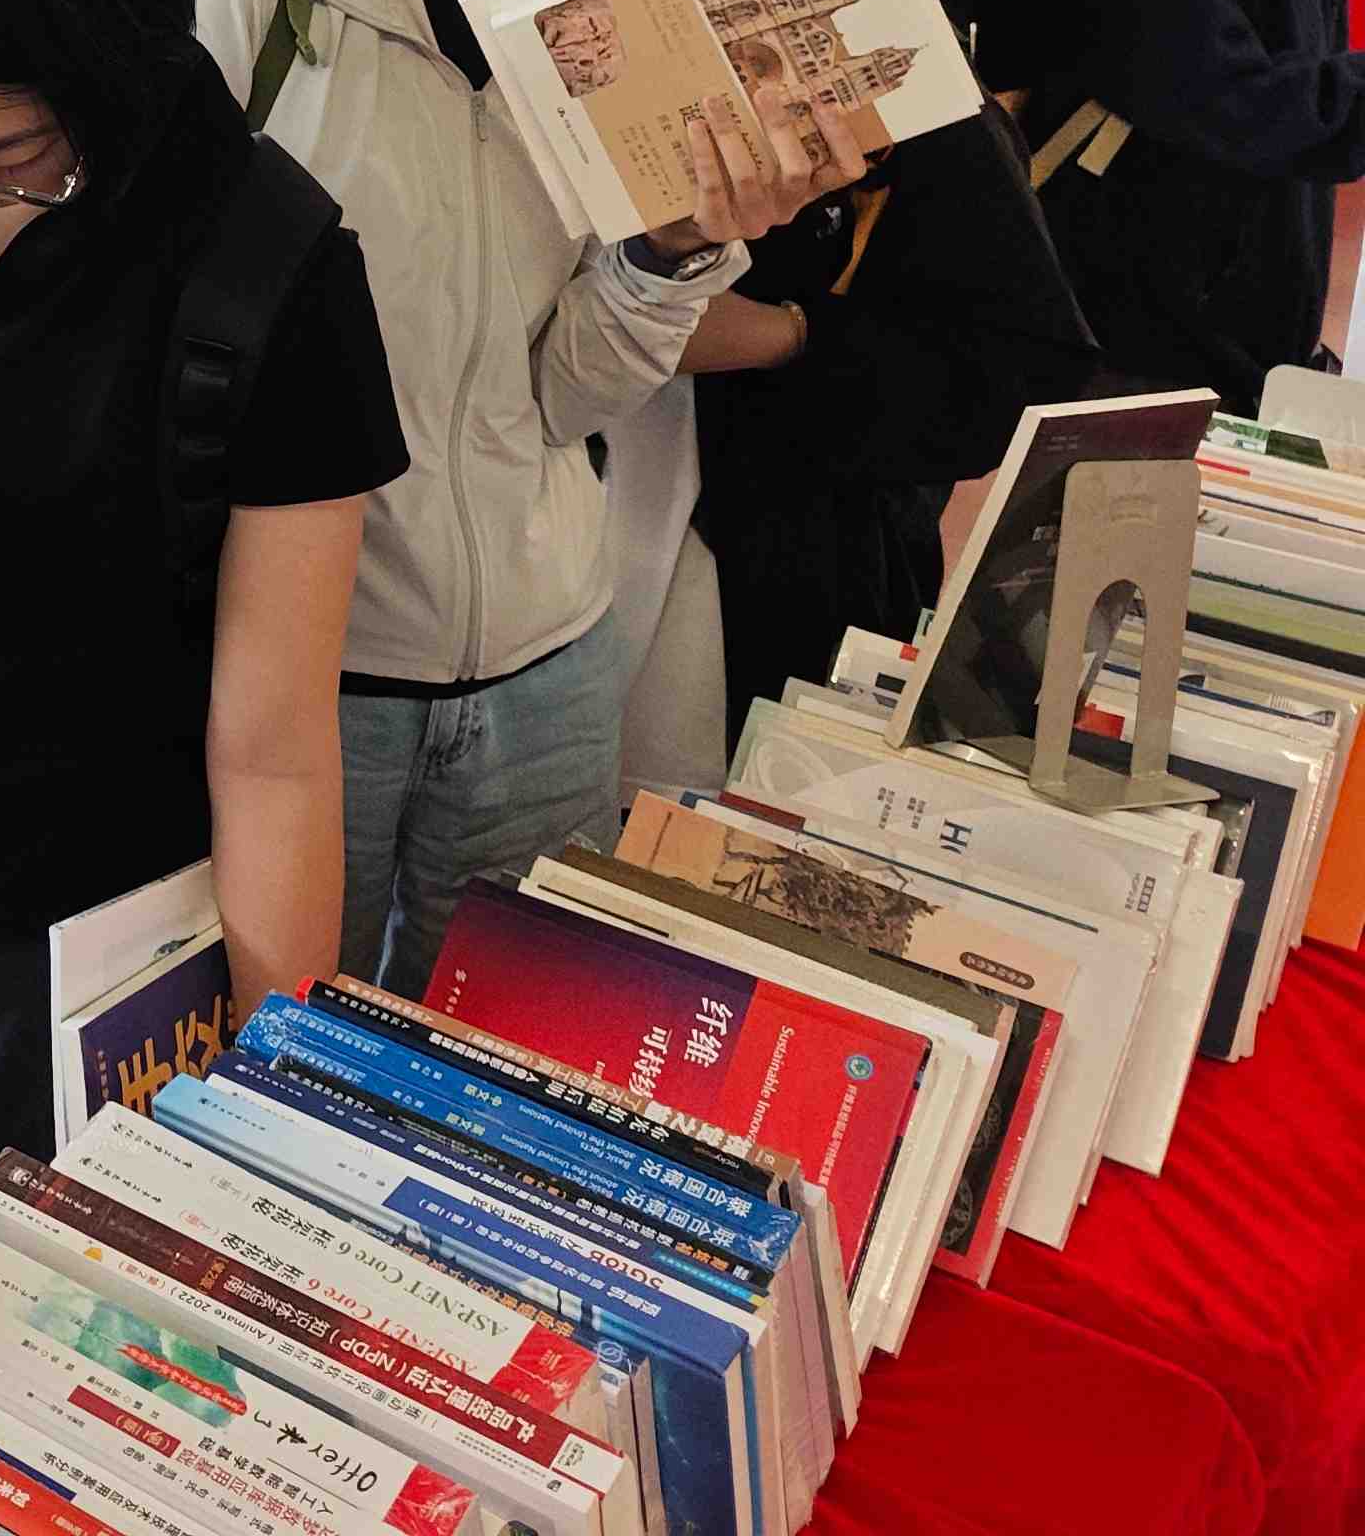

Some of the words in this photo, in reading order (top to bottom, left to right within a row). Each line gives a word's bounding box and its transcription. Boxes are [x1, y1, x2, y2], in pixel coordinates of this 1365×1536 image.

[678, 996, 736, 1070] 纤维
[758, 1024, 795, 1101] Sustainable
[619, 1184, 737, 1251] 联合国概况
[636, 1155, 753, 1220] 联合国概况
[248, 1193, 336, 1250] 框架揭秘
[335, 1238, 352, 1257] 6
[217, 1228, 305, 1285] 框架揭秘
[304, 1275, 321, 1294] 6
[348, 1246, 406, 1288] Core
[319, 1284, 374, 1323] Core
[400, 1274, 509, 1340] ASP.NET
[374, 1314, 478, 1378] ASP.NET
[39, 1448, 183, 1536] 理技术及应用案例分析
[196, 1434, 336, 1519] 人工智能数学基础
